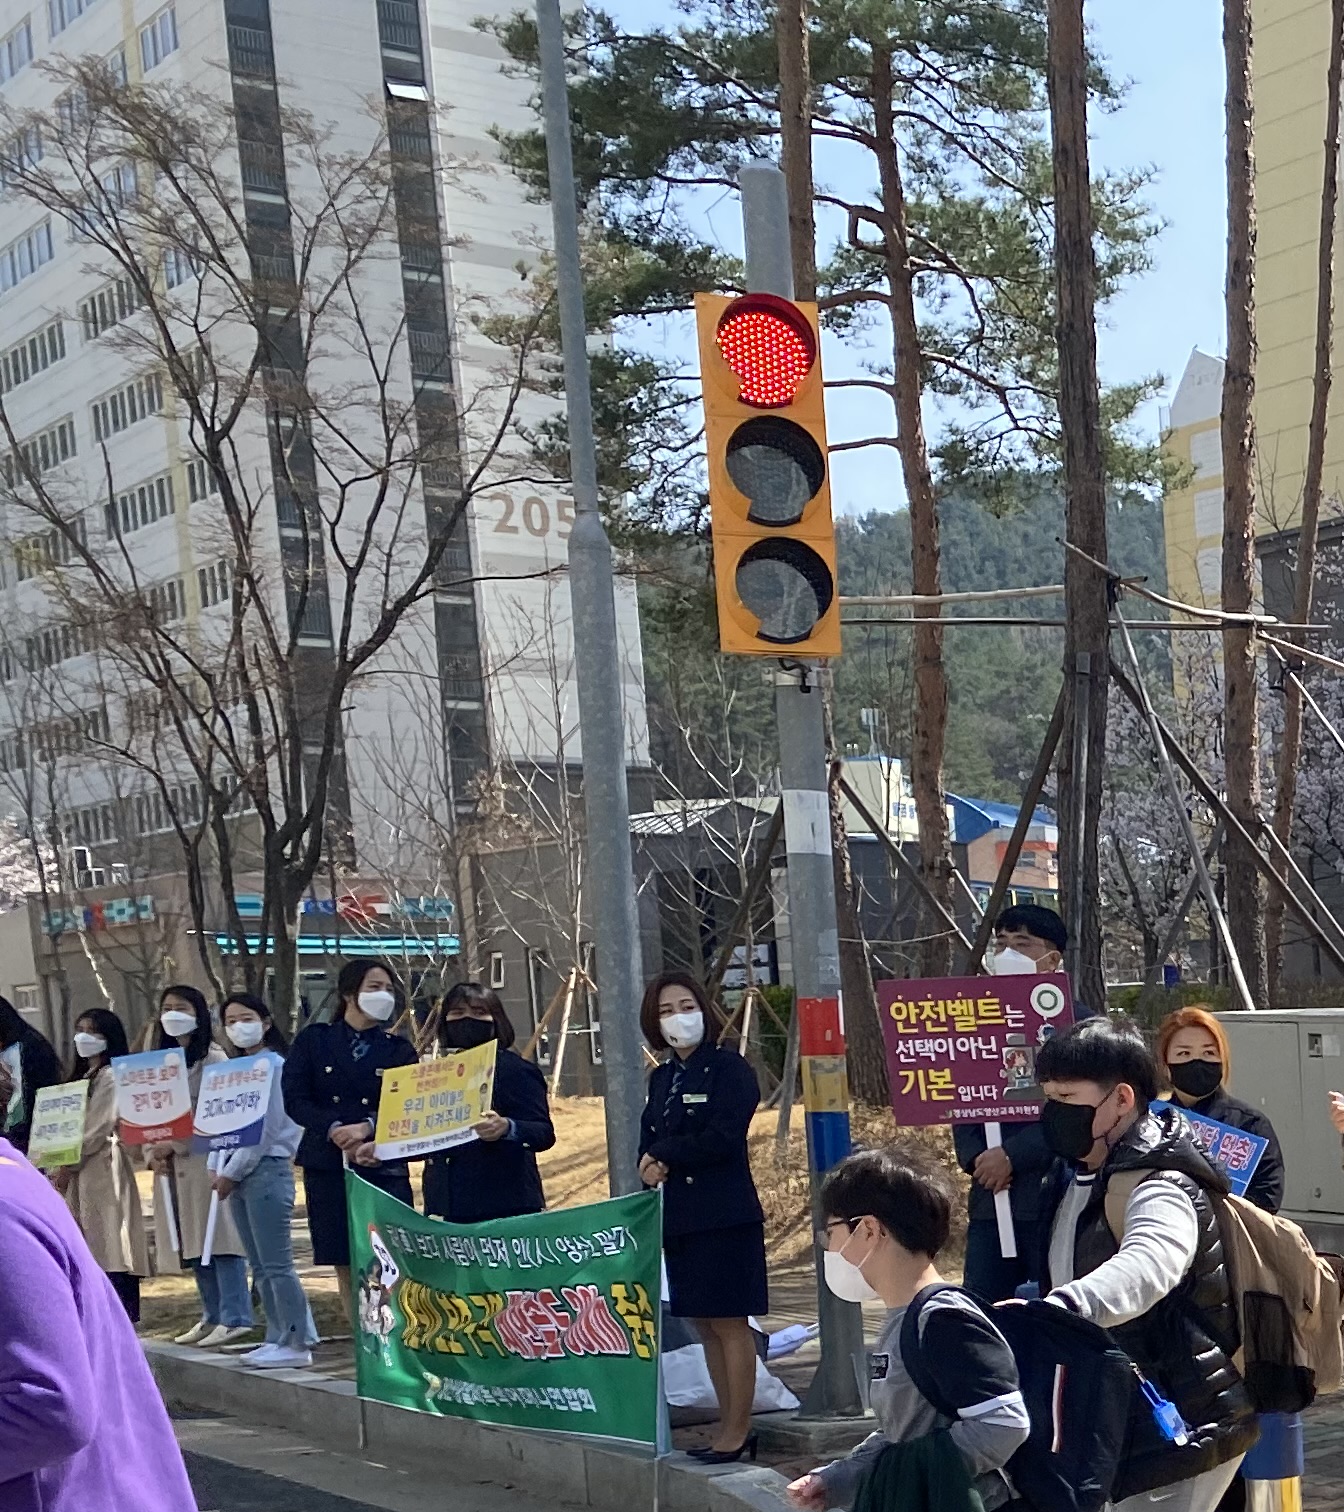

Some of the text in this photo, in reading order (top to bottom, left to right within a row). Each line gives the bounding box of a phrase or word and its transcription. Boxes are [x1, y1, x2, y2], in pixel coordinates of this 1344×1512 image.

[890, 997, 1026, 1034] 안전벨트는
[895, 1036, 999, 1063] 선택이 아닌
[404, 1090, 464, 1115] 우리 아이들의
[388, 1104, 472, 1138] 안전을 지켜주세요
[482, 1235, 510, 1268] 먼저
